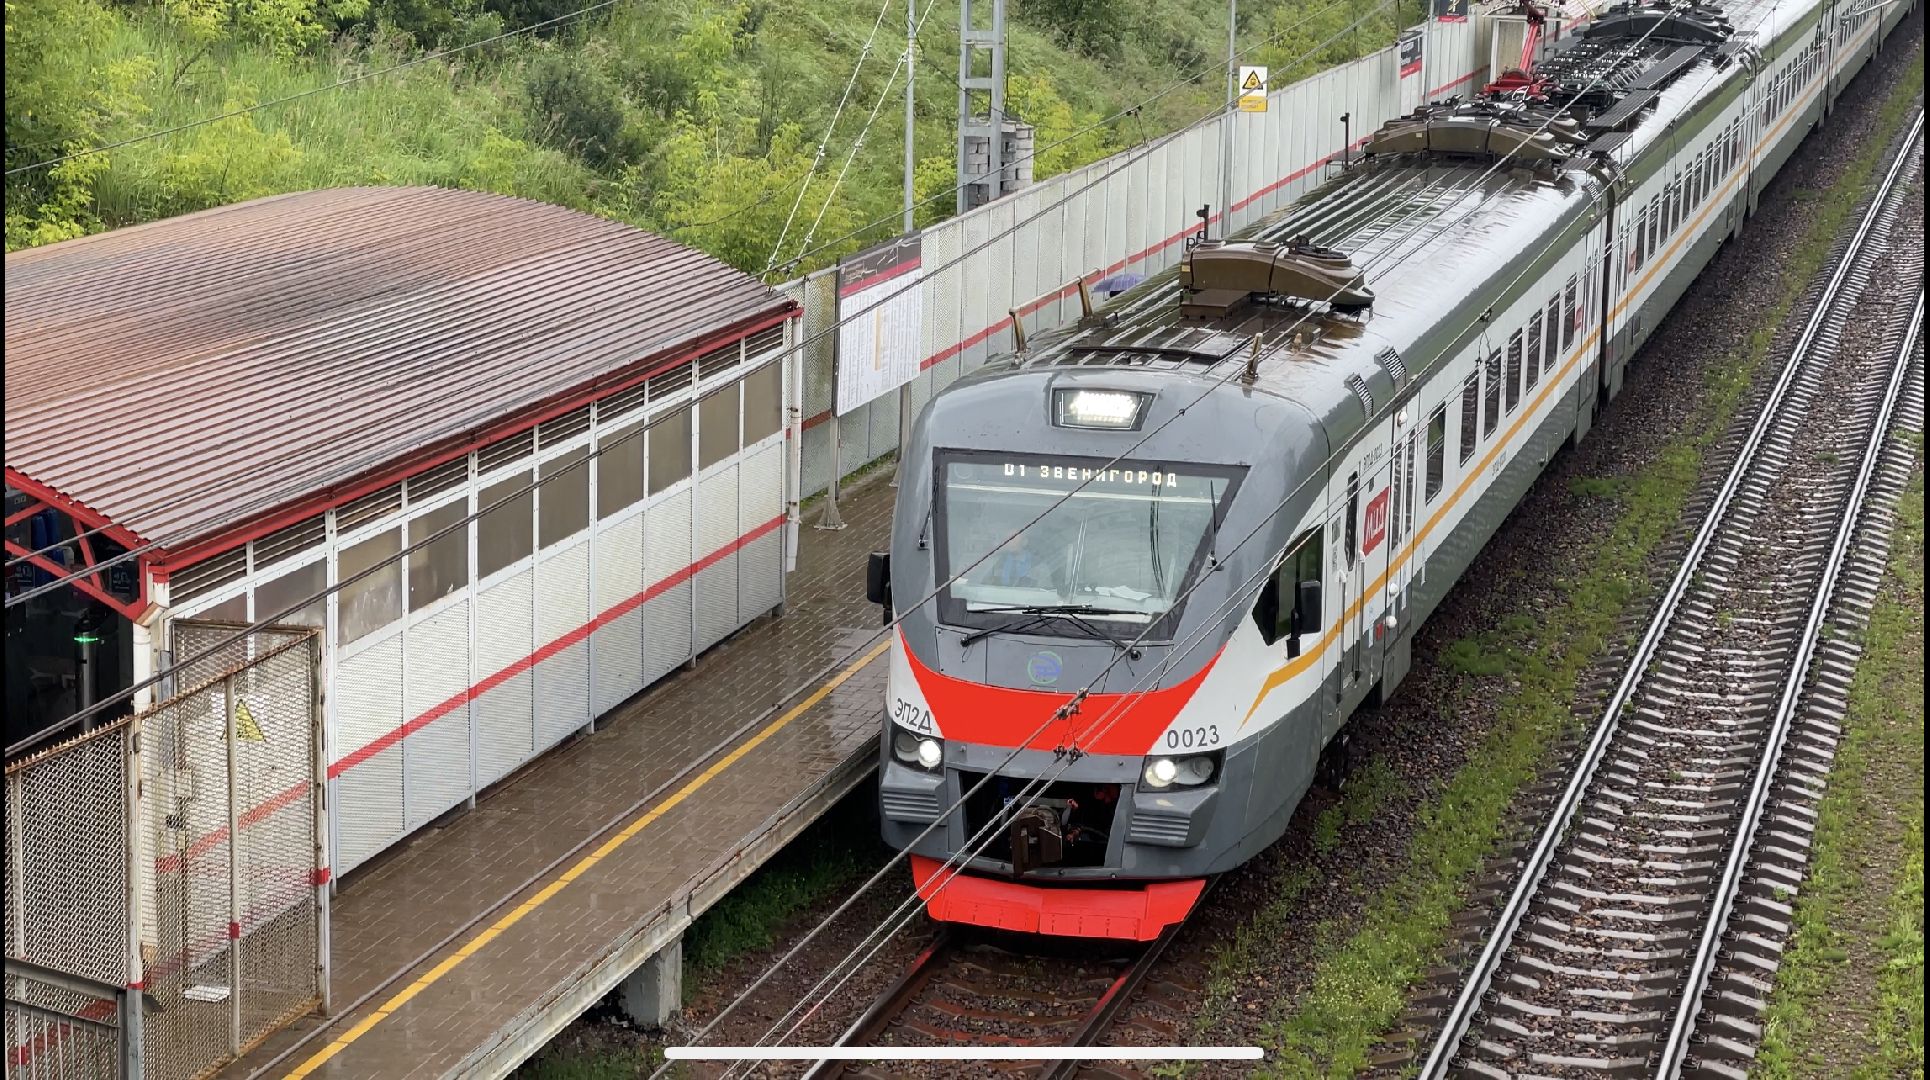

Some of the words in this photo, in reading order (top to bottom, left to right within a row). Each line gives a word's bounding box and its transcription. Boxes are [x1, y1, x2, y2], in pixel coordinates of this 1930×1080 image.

[1040, 465, 1177, 487] ЗВЕНИГОРОД
[894, 698, 933, 734] ЭП2Д
[1166, 724, 1220, 748] 0023
